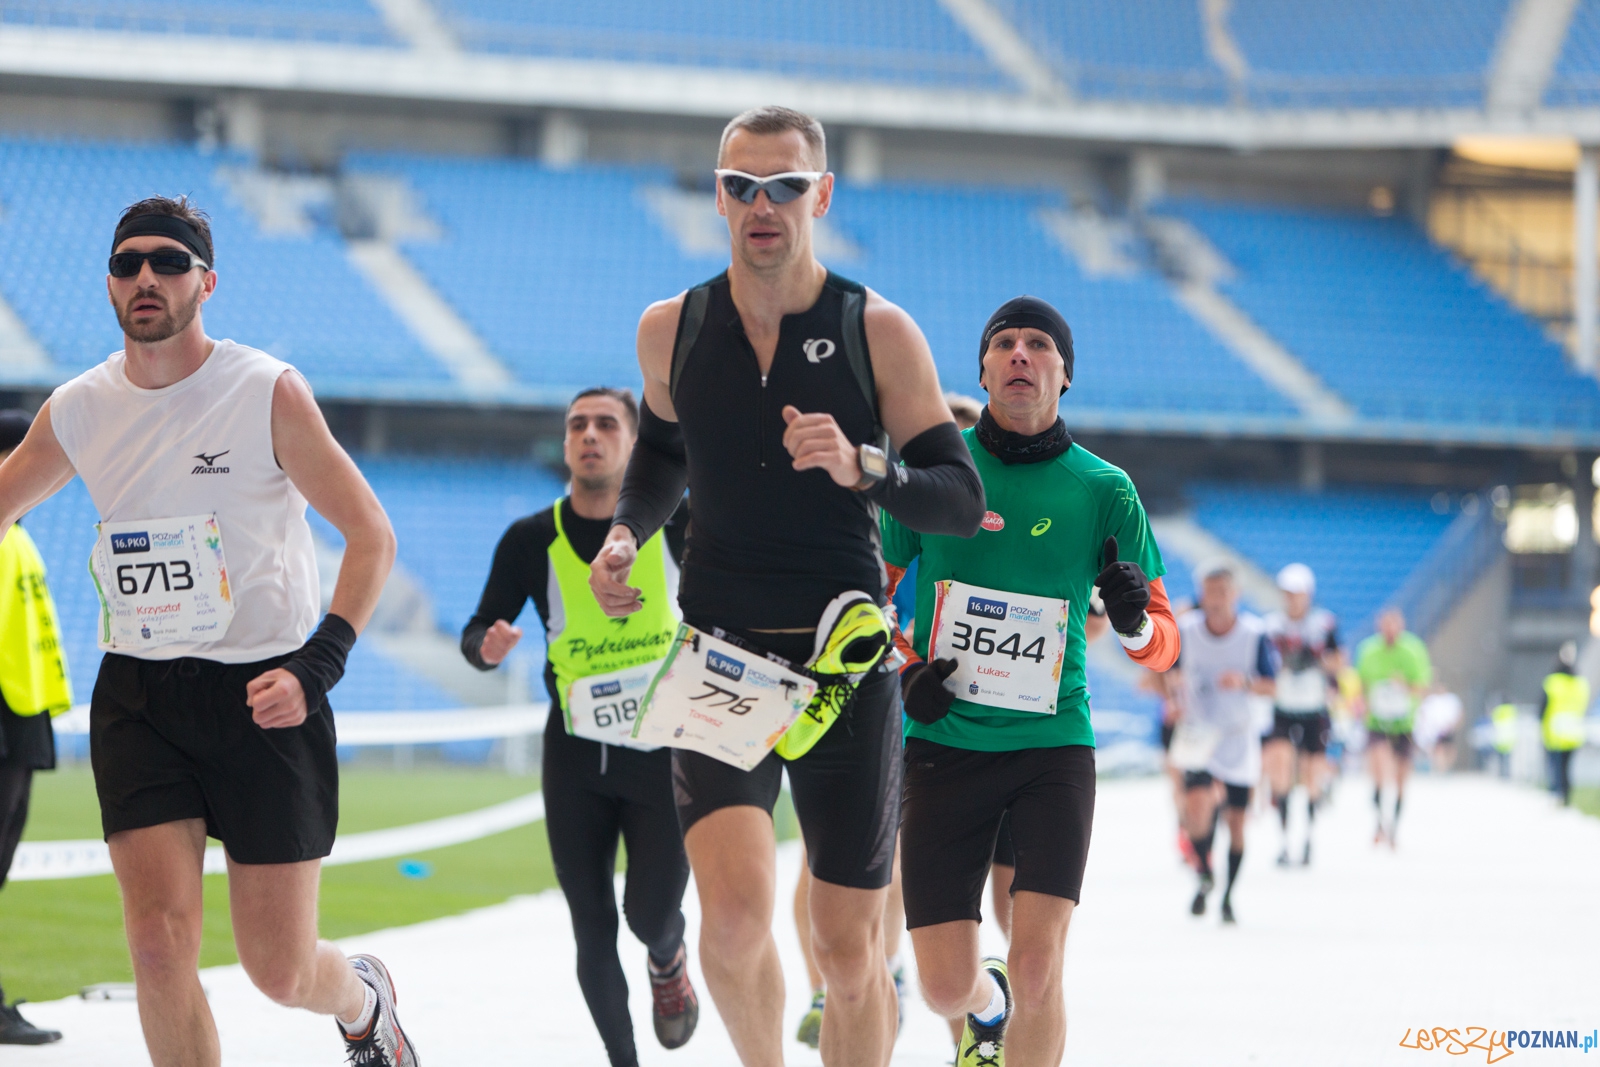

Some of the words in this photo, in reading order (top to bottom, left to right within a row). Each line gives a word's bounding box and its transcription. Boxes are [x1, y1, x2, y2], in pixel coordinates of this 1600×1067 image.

[117, 560, 194, 595] 6713
[136, 603, 181, 615] Krzysztof
[1010, 613, 1040, 623] maraton
[952, 621, 1046, 664] 3644
[977, 665, 1011, 679] Łukasz
[689, 681, 758, 715] 776
[594, 696, 643, 728] 618
[689, 708, 723, 728] Tomasz
